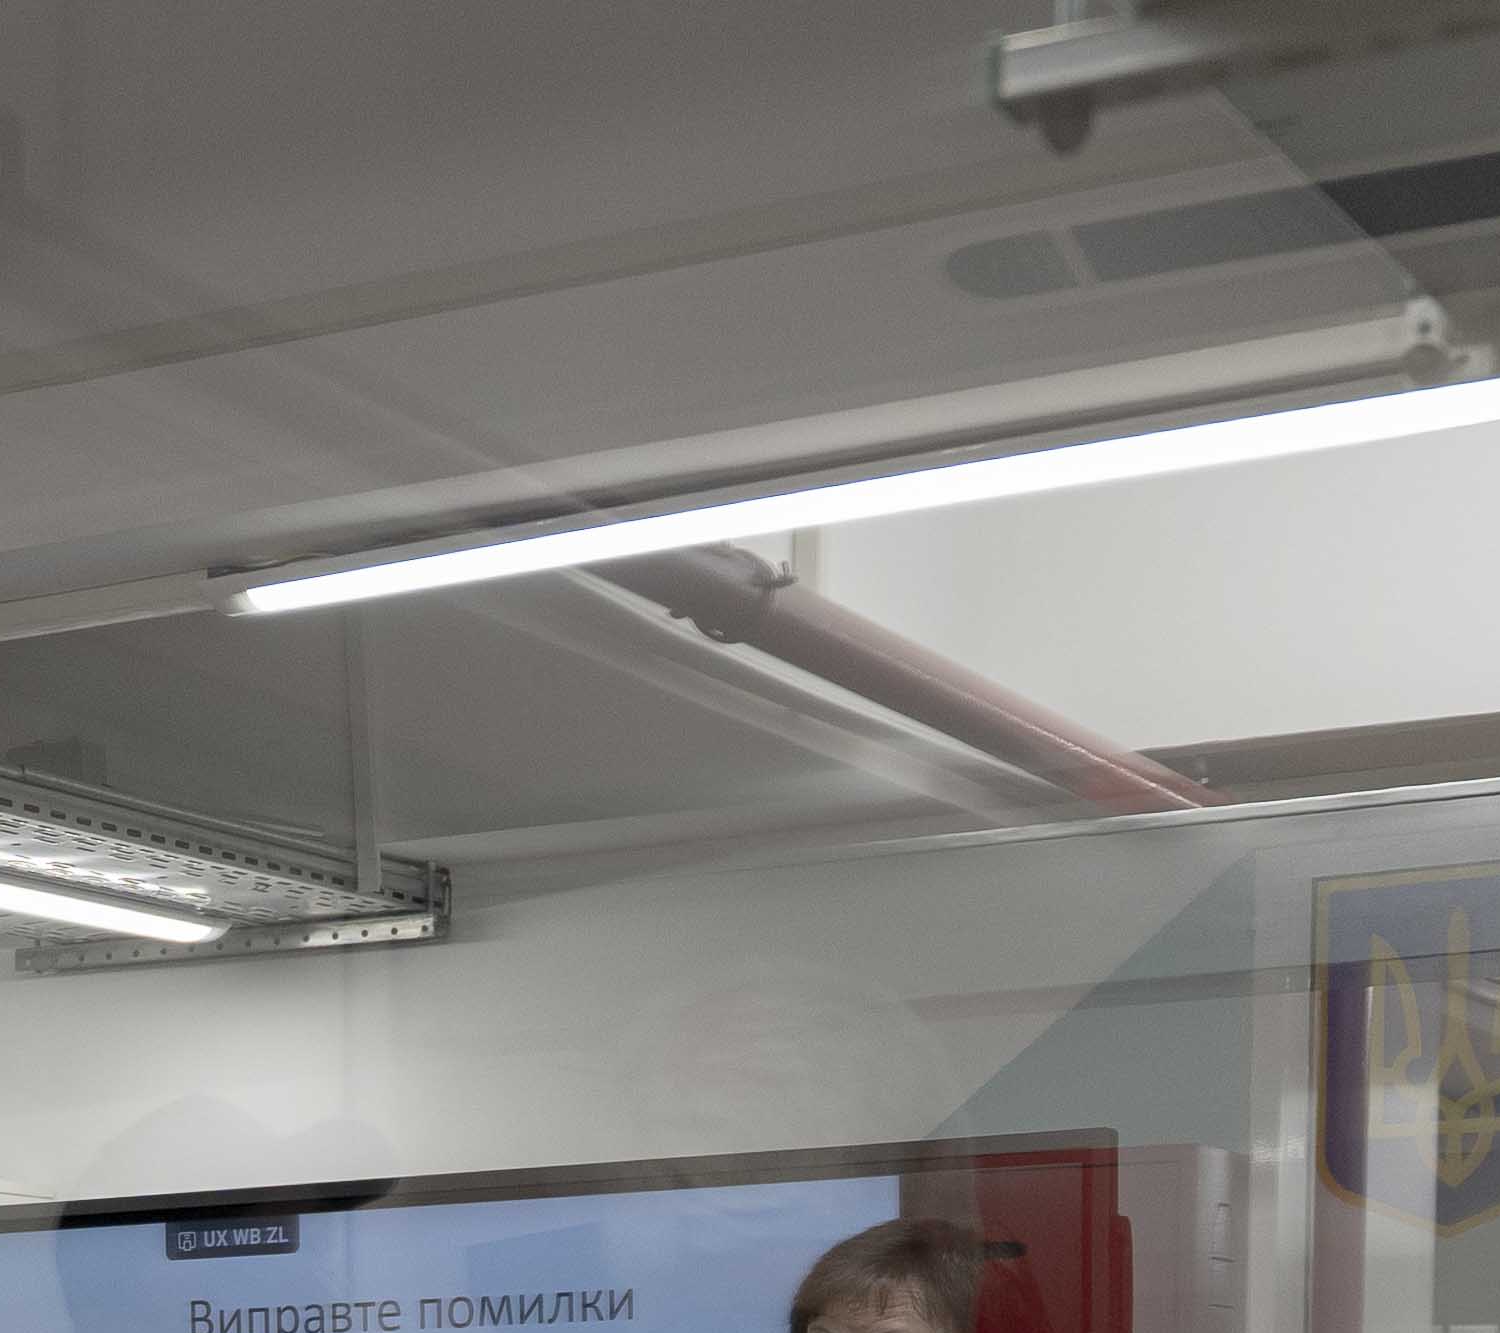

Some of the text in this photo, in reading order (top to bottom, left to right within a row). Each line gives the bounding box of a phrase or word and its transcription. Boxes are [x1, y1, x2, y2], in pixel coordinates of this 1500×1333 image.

[203, 1225, 290, 1248] UX WB ZL
[417, 1287, 635, 1330] помилки
